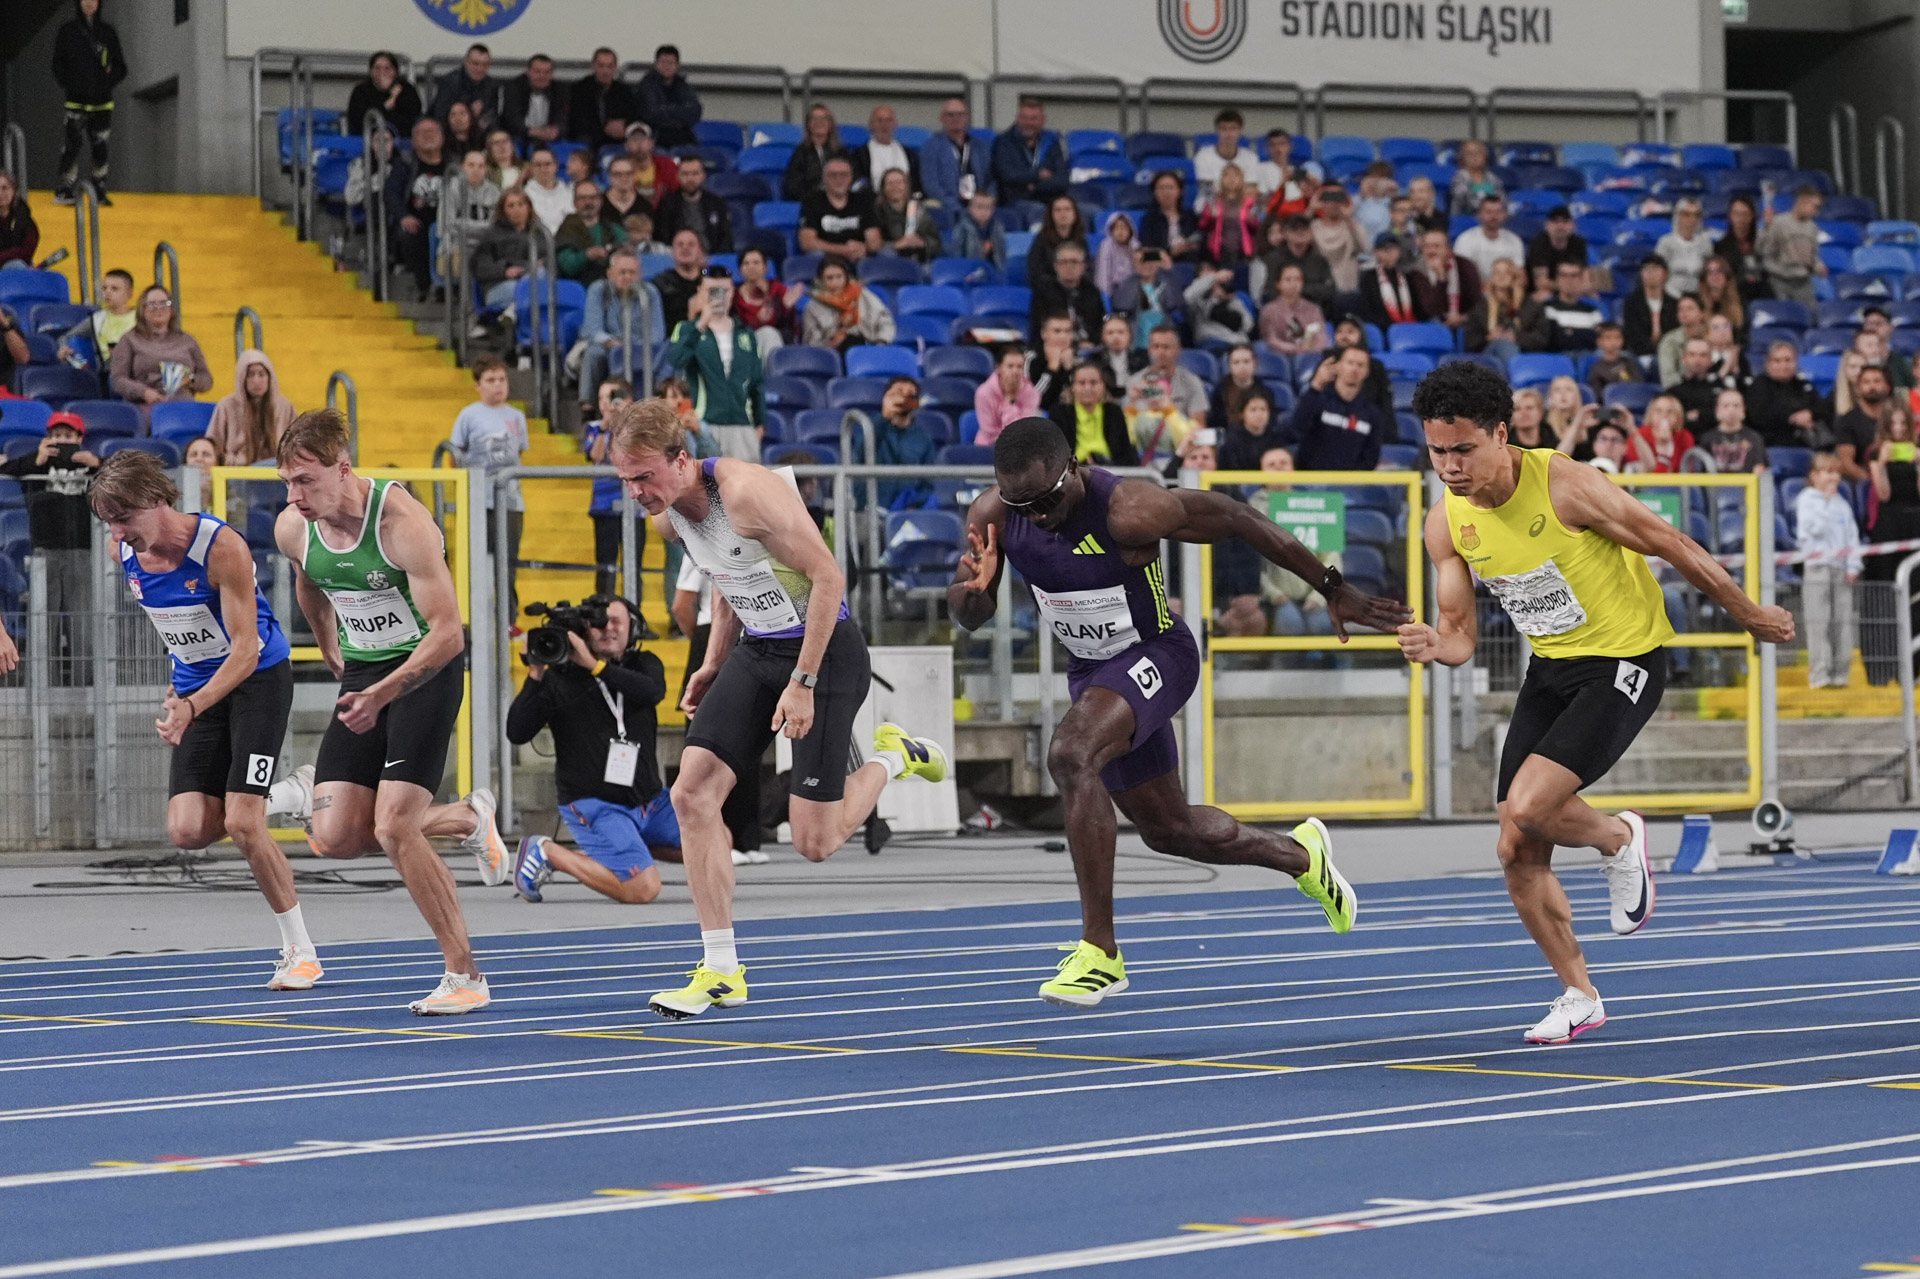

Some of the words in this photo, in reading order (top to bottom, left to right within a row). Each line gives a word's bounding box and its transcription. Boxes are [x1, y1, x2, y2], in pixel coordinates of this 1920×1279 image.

[1281, 1, 1425, 40] STADION
[1437, 0, 1552, 57] ŚLĄSKI
[342, 611, 403, 633] KRUPA
[1054, 620, 1117, 640] GLAVE
[161, 628, 216, 646] BURA
[1137, 666, 1159, 690] 5
[1622, 669, 1641, 696] 4
[254, 758, 268, 783] 8
